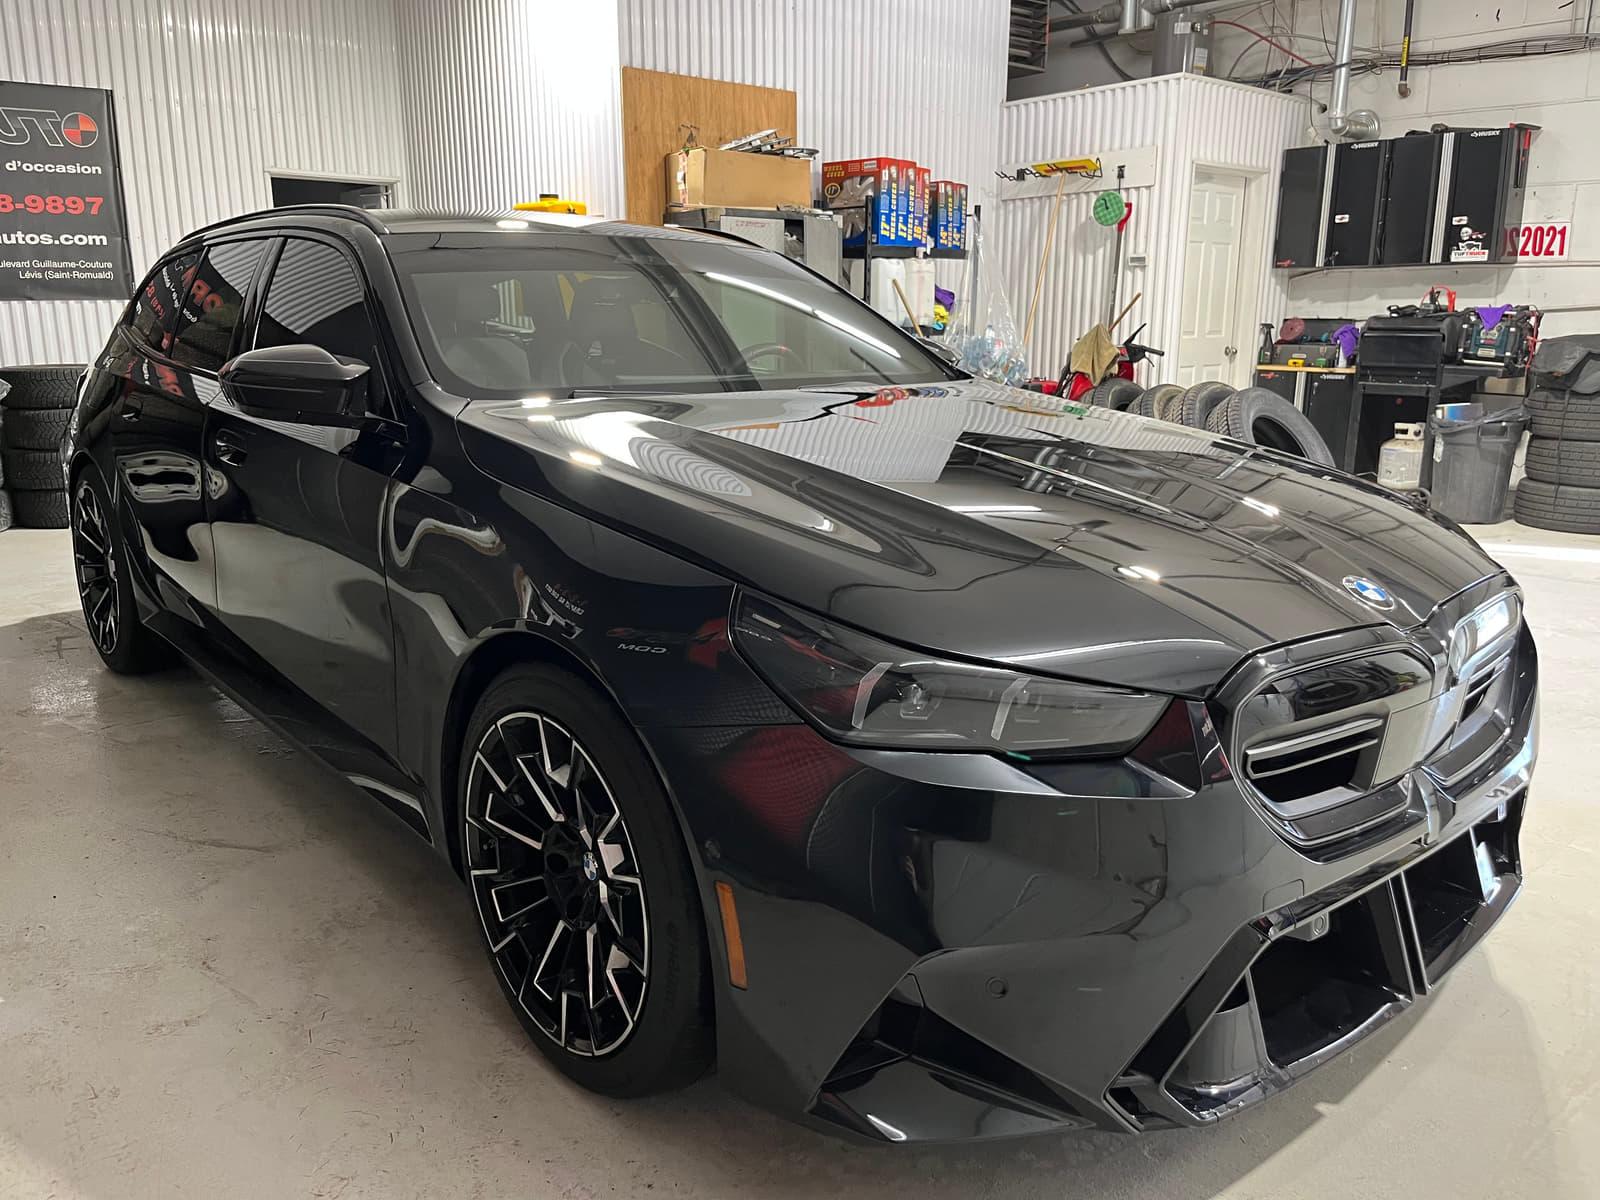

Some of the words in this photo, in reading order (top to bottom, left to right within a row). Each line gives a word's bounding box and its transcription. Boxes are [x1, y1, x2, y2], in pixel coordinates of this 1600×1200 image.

[5, 160, 102, 174] d'occasion
[0, 231, 108, 246] utos.com
[1519, 226, 1567, 256] 2021
[32, 260, 113, 269] Guillaume-Couture
[19, 270, 43, 279] Lévis
[45, 270, 114, 280] (Saint-Romuald)
